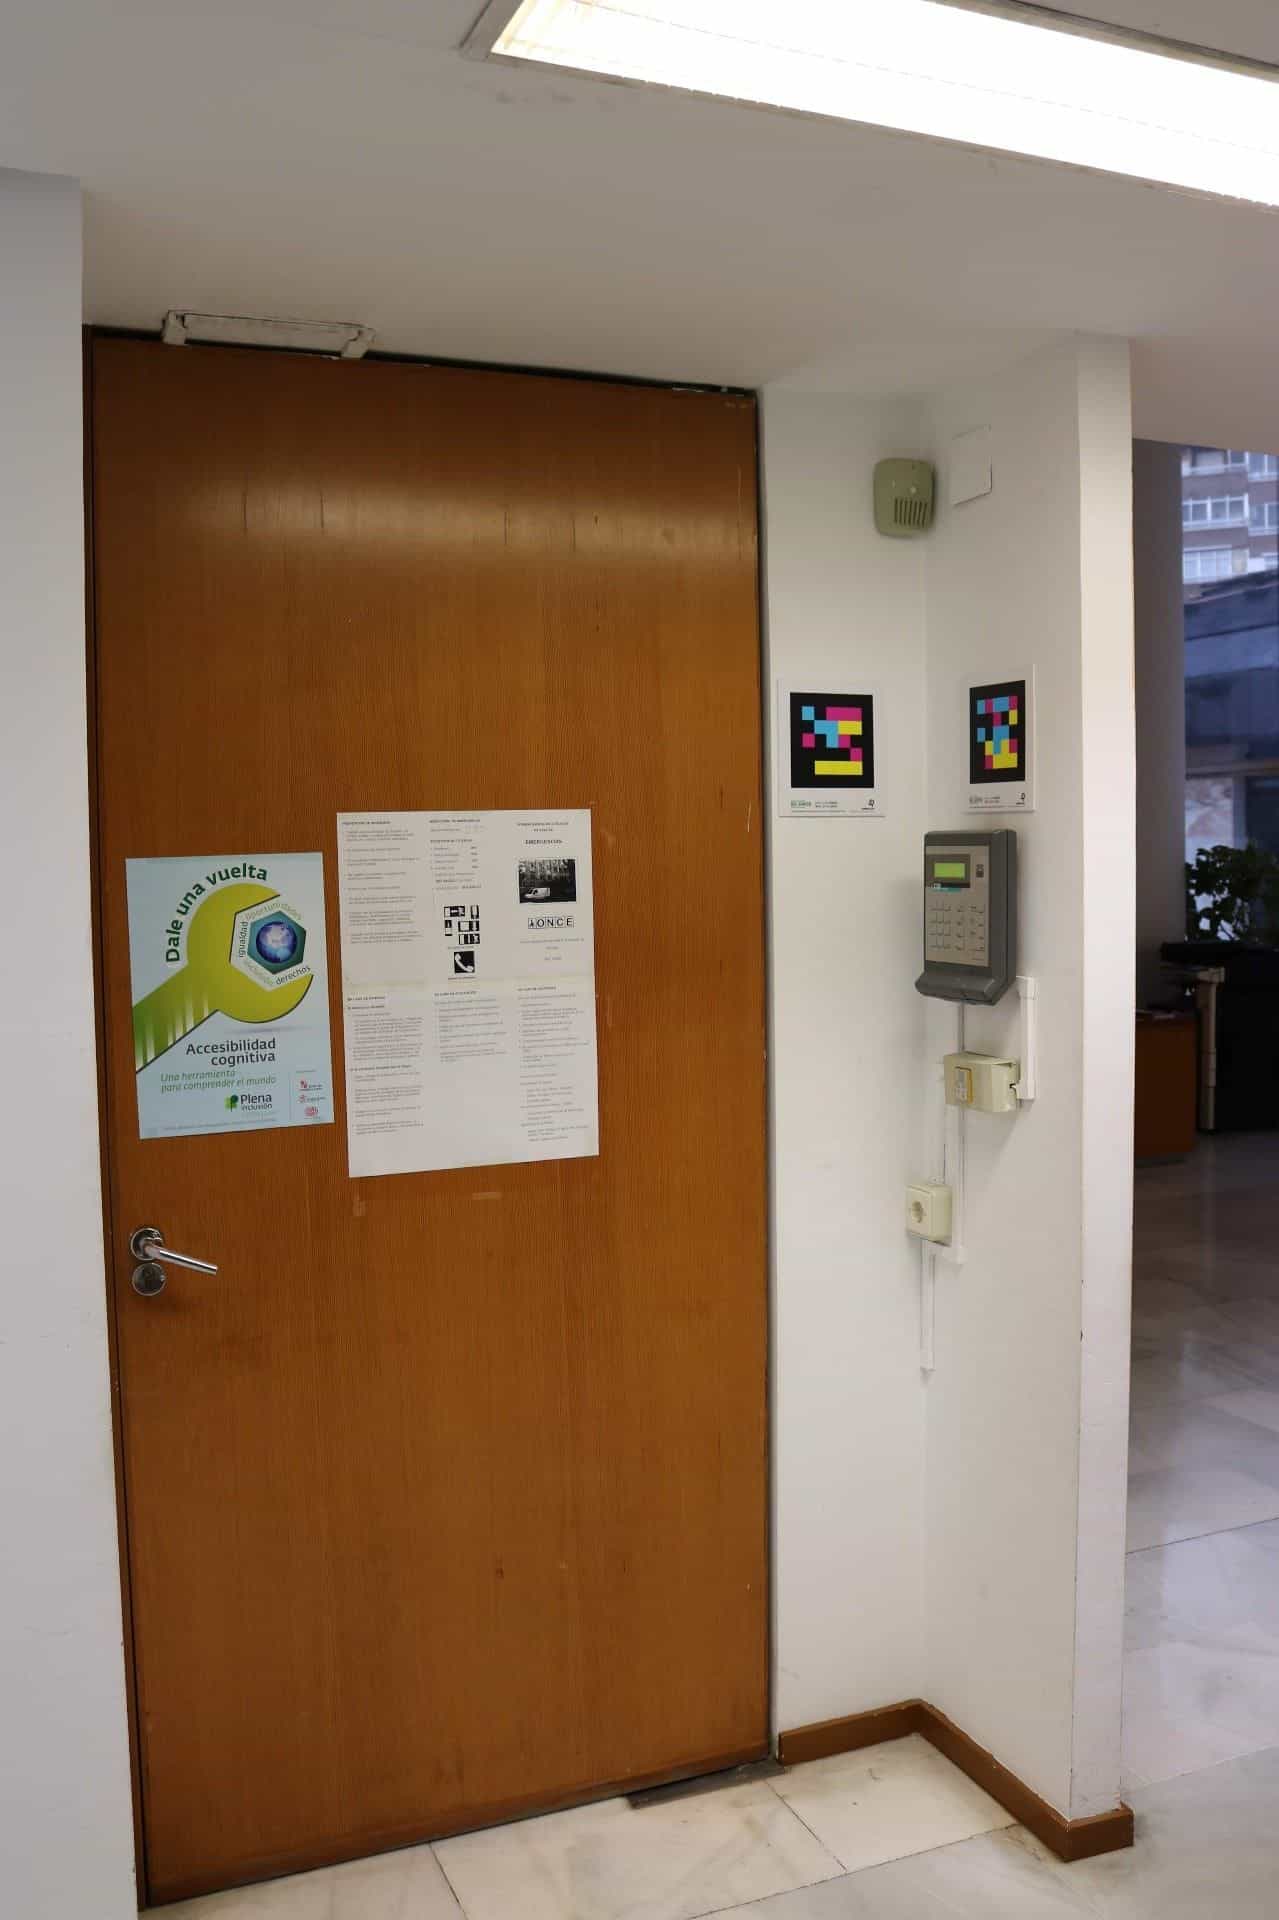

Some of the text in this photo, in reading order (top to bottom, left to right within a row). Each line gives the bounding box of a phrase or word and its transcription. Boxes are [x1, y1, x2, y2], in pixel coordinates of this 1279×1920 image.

[166, 863, 267, 963] Dale una vuelta
[536, 916, 574, 929] ONCE
[275, 966, 311, 986] derechos
[186, 1038, 276, 1056] Accesibilidad
[211, 1052, 276, 1067] cognitiva
[160, 1070, 236, 1082] Una herramienta
[161, 1083, 182, 1094] para
[183, 1079, 235, 1092] comprender
[246, 1076, 277, 1087] mundo
[240, 1093, 272, 1105] Plena
